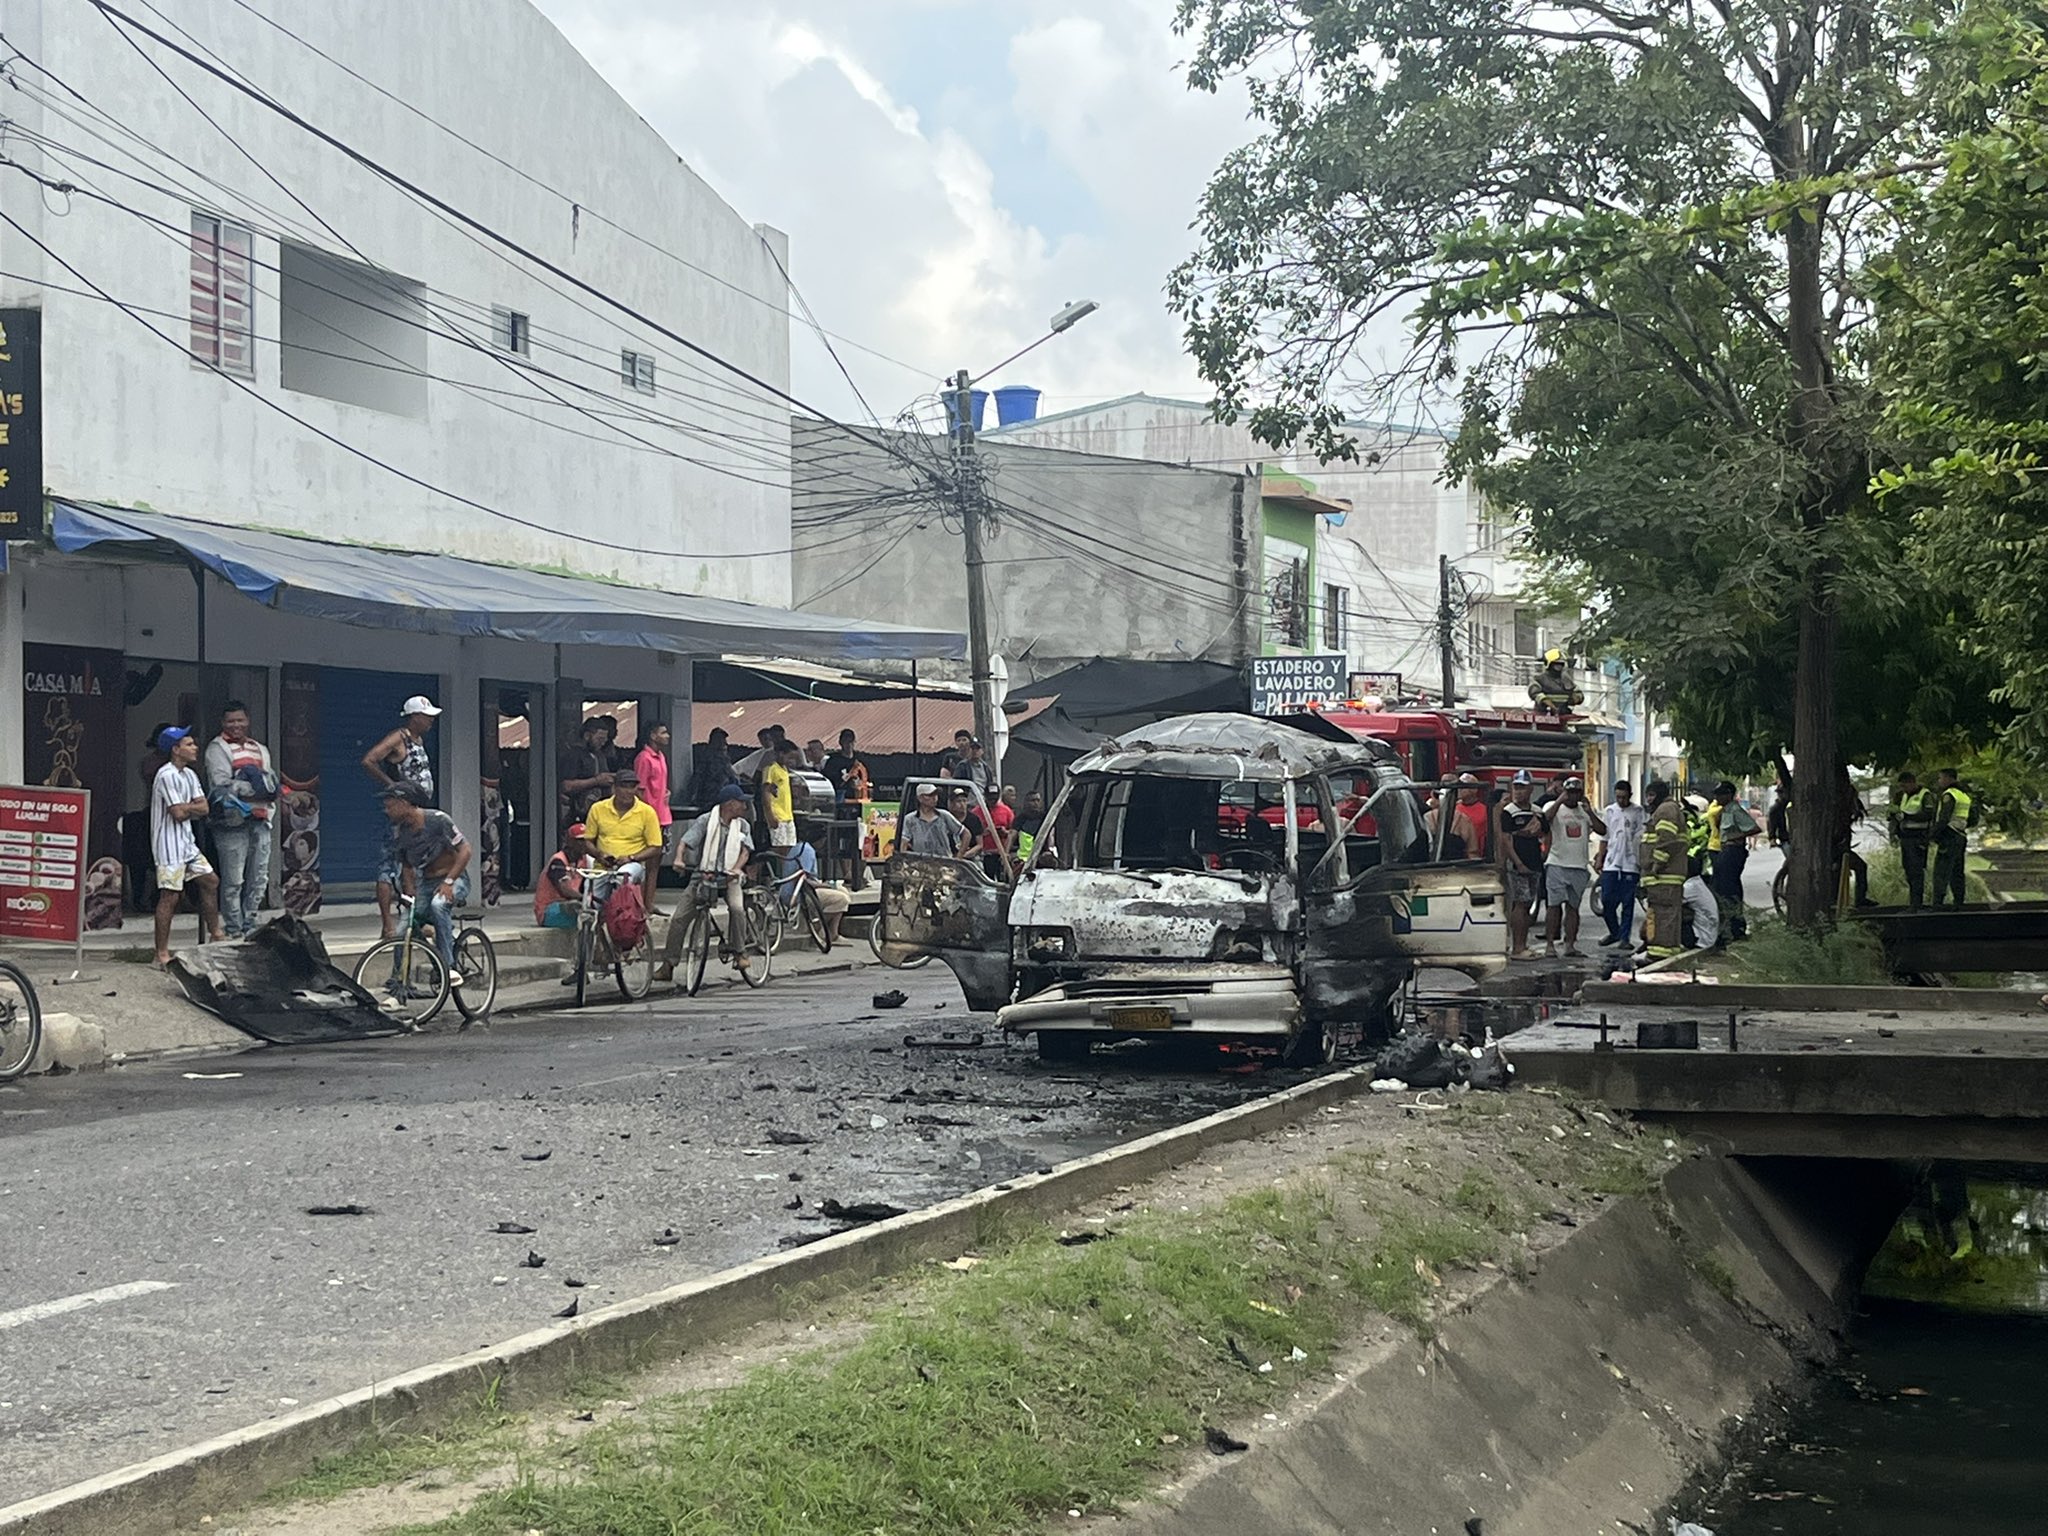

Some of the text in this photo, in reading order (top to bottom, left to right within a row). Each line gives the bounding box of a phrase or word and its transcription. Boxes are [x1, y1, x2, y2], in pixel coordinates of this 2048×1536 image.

[1254, 659, 1342, 675] ESTADERO Y
[24, 672, 67, 693] CASA
[1255, 676, 1336, 691] LAVADERO
[36, 801, 51, 812] UN
[51, 803, 78, 814] SOLO
